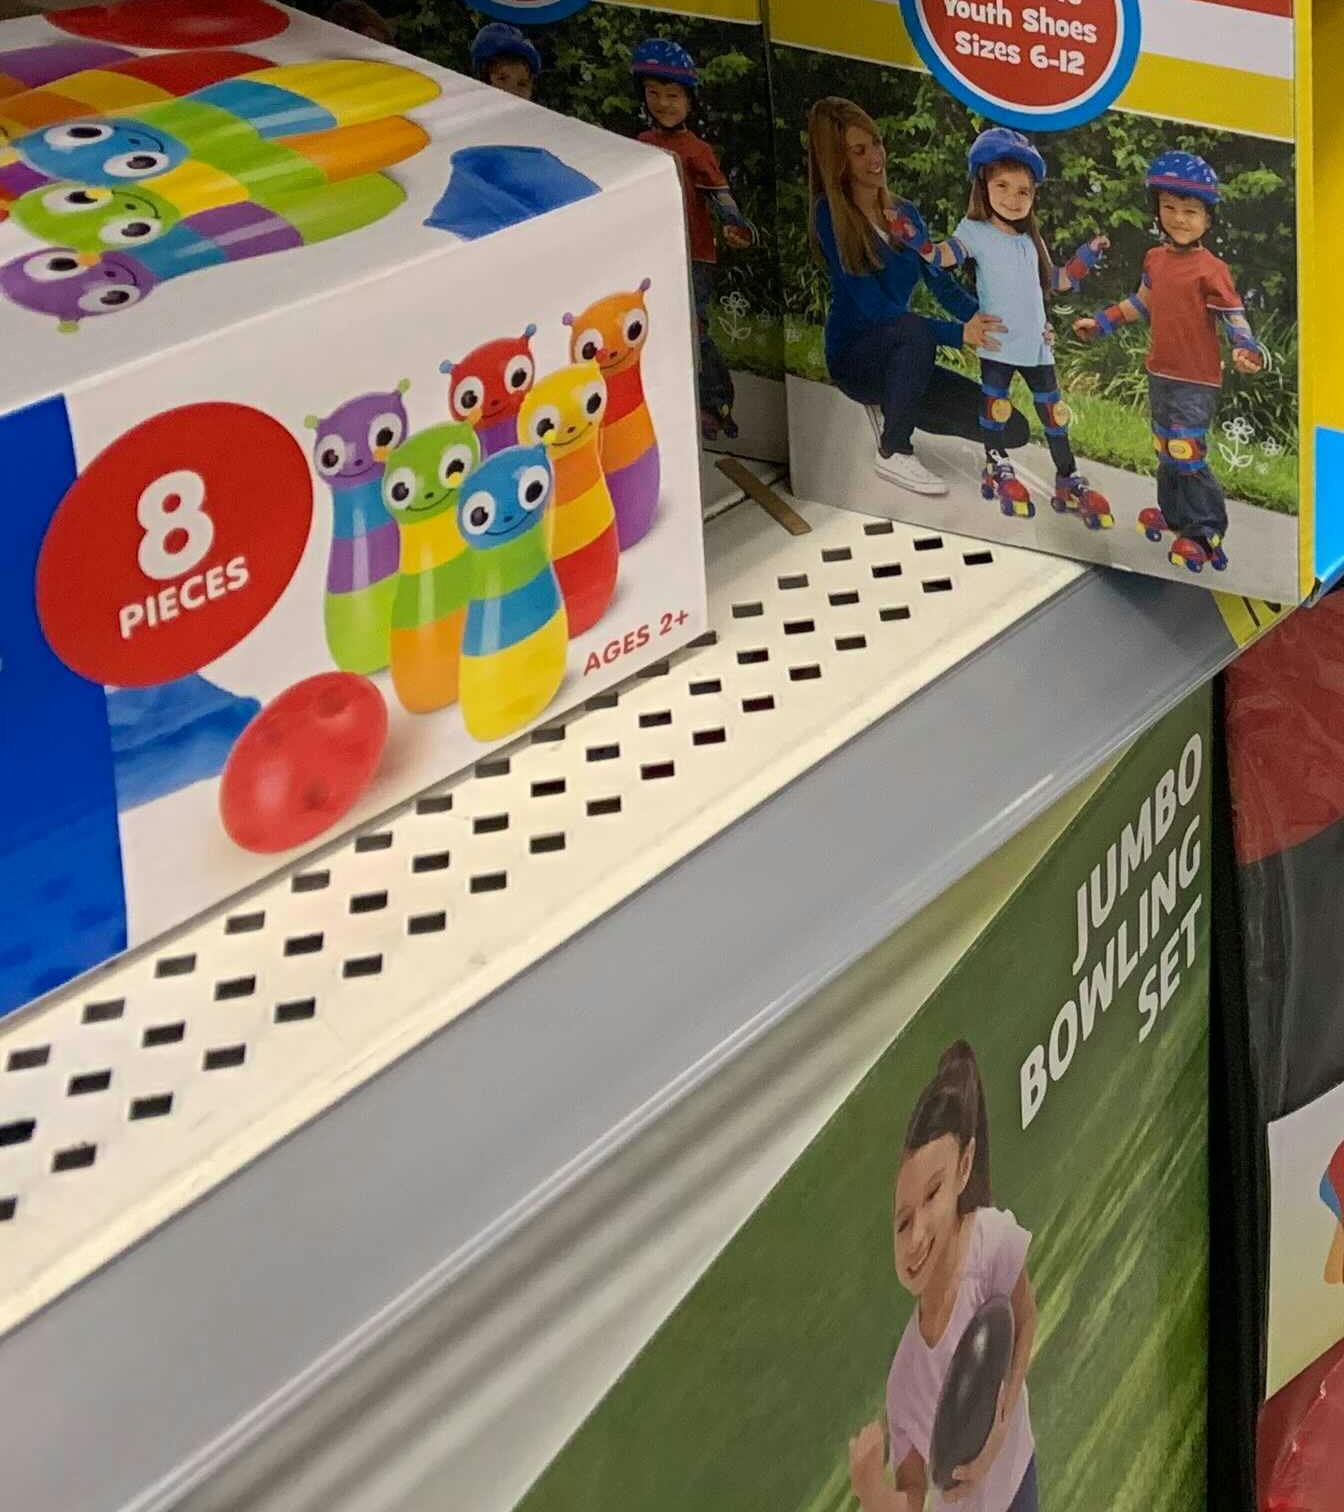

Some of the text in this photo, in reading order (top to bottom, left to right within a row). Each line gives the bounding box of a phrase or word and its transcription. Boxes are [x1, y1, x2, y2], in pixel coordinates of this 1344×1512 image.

[955, 31, 1085, 77] Sizes 6-12
[1021, 8, 1097, 43] Shoes
[136, 469, 214, 581] 8
[117, 556, 249, 641] PIECES
[583, 608, 690, 677] AGES 2+
[1072, 732, 1201, 974] JUMBO
[1020, 816, 1201, 1130] BOWLING
[1137, 894, 1201, 1043] SET
